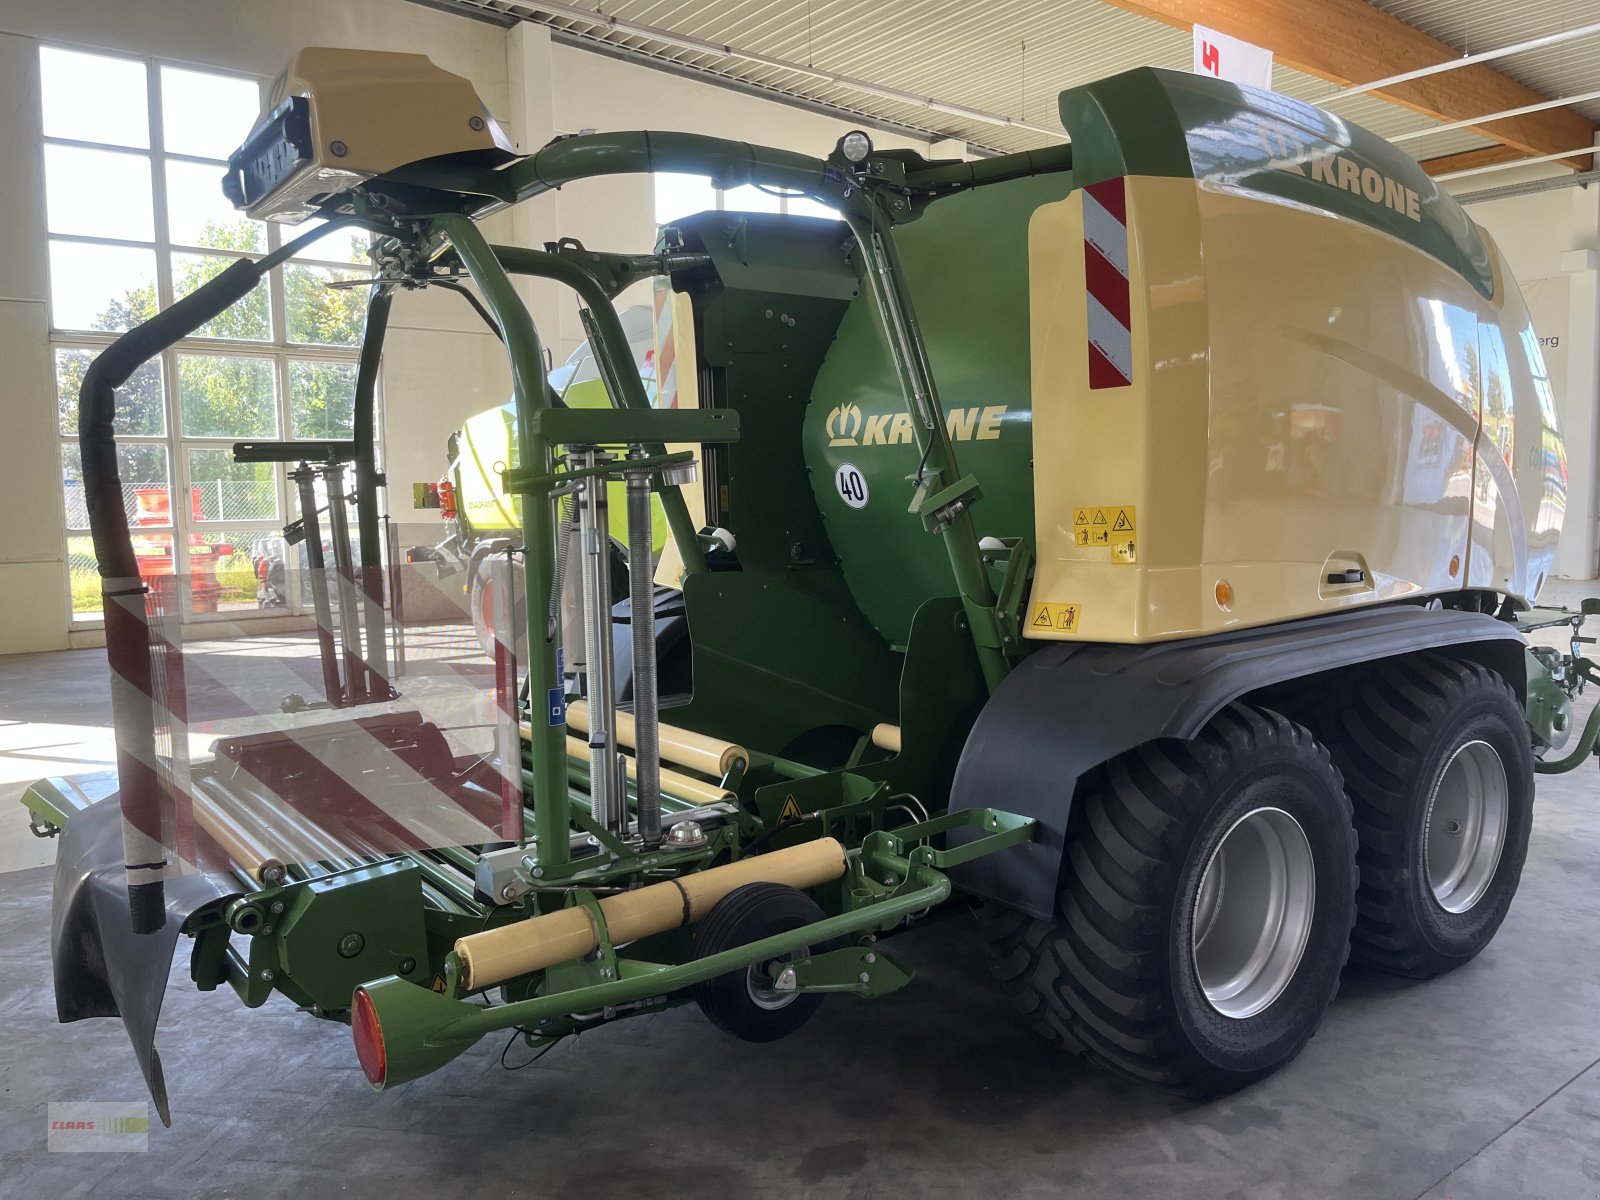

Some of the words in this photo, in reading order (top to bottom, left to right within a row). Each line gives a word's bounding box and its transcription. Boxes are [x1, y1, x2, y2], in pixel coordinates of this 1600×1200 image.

[1310, 146, 1421, 223] KRONE
[862, 404, 1008, 446] KRNE
[840, 471, 865, 502] 40
